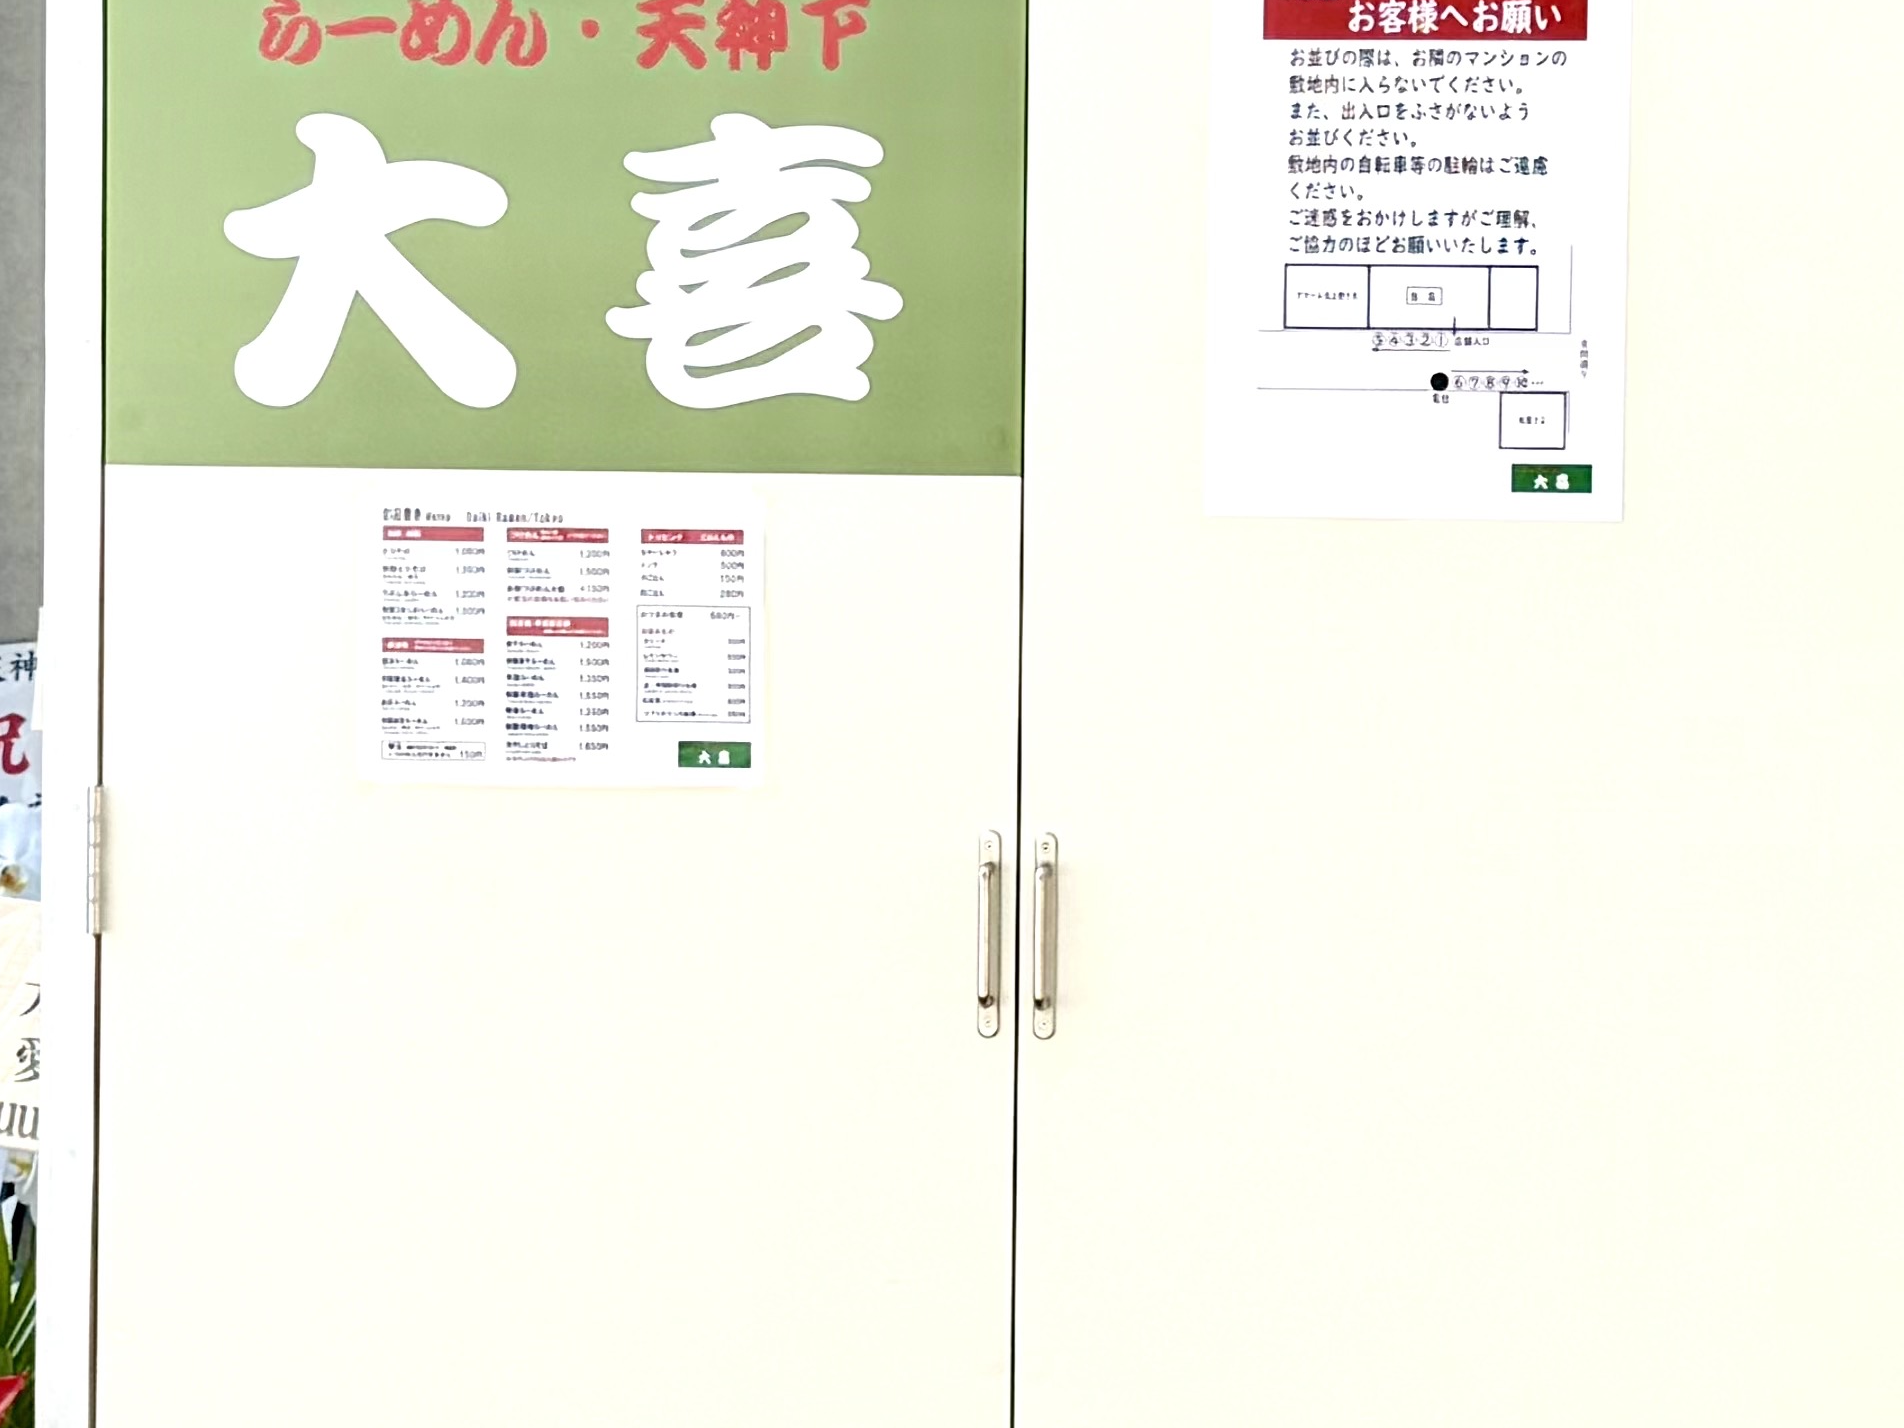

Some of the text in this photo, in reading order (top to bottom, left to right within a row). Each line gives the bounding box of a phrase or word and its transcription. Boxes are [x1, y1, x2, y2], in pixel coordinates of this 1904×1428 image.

[1289, 127, 1417, 148] お並びください。
[1289, 181, 1364, 202] ください。
[222, 112, 904, 410] 大喜
